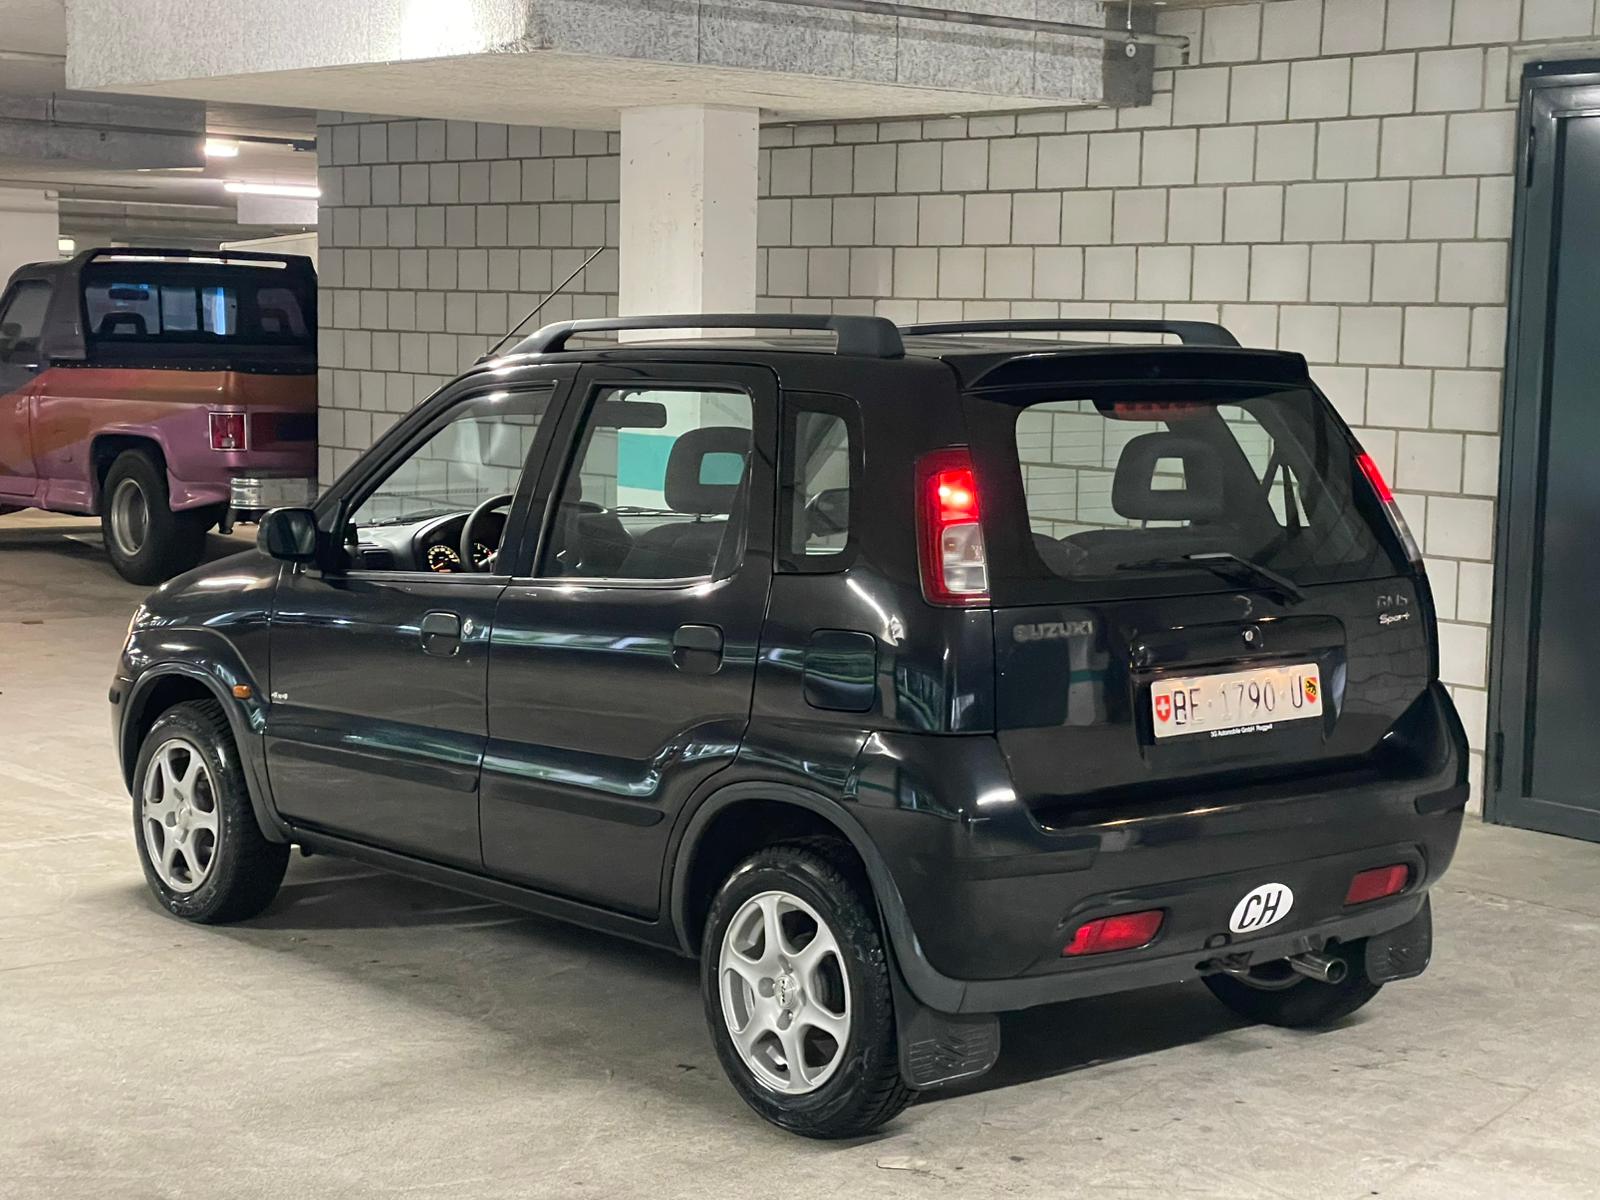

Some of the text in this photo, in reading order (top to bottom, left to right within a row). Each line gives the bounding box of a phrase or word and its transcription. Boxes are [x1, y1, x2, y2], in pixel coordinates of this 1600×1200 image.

[1012, 620, 1094, 643] SUZUKI
[1379, 611, 1410, 625] Sport
[1173, 674, 1304, 726] BE 1790 U
[1237, 889, 1283, 930] CH
